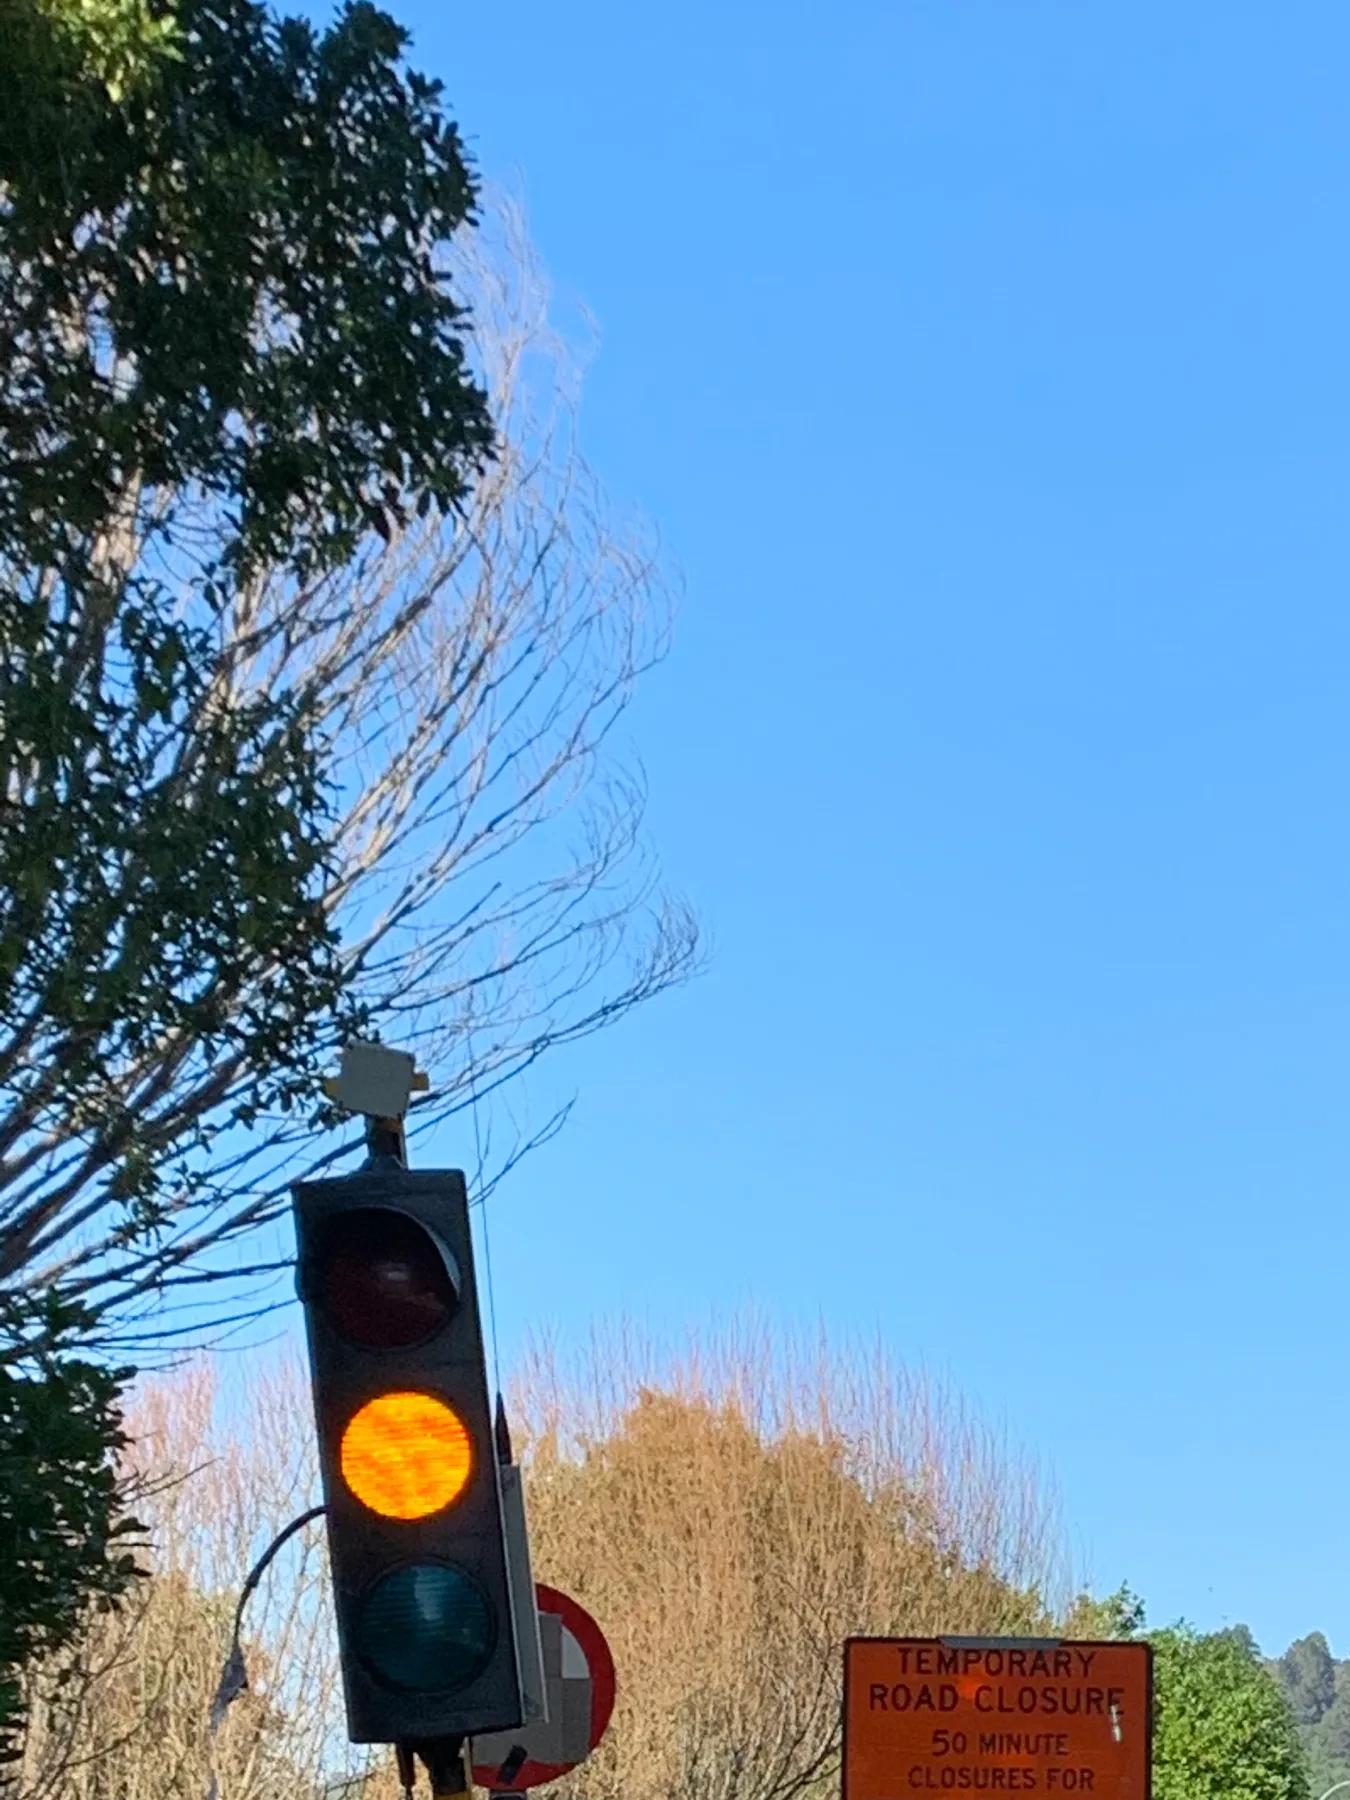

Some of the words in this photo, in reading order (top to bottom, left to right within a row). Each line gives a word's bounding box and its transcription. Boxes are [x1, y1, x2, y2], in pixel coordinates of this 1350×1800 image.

[898, 1647, 1096, 1677] TEMPORARY
[869, 1684, 959, 1712] ROAD
[974, 1686, 1125, 1716] CLOSURE
[932, 1729, 967, 1757] 50
[979, 1733, 1069, 1756] MINUTE
[908, 1766, 1036, 1790] CLOSURES
[1047, 1768, 1094, 1790] FOR
